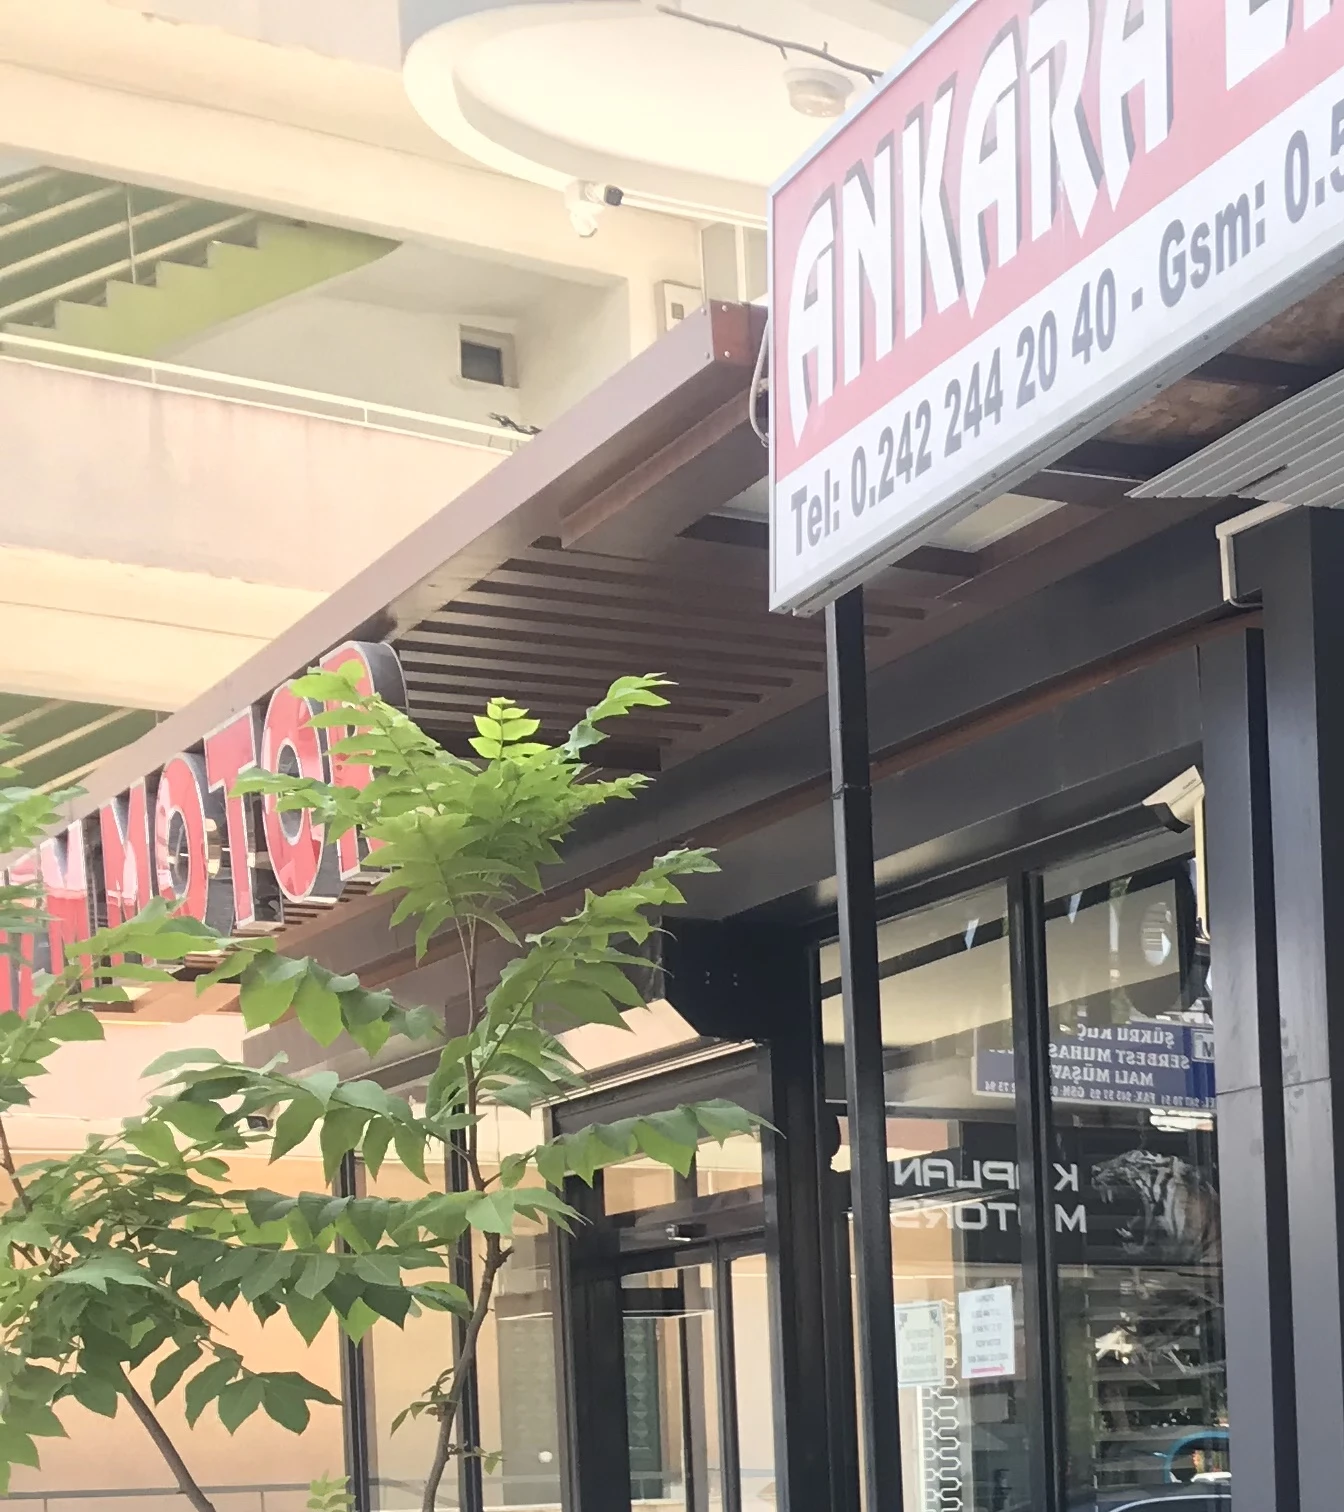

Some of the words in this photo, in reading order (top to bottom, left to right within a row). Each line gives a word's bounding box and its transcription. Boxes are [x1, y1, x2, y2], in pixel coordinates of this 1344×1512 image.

[787, 0, 1174, 449] ANKARA
[790, 469, 840, 556] Tel:
[851, 399, 933, 516] 0.242
[943, 346, 1003, 459] 244
[1016, 321, 1058, 409] 20
[1071, 267, 1117, 365] 40
[1158, 180, 1267, 309] Gsm:
